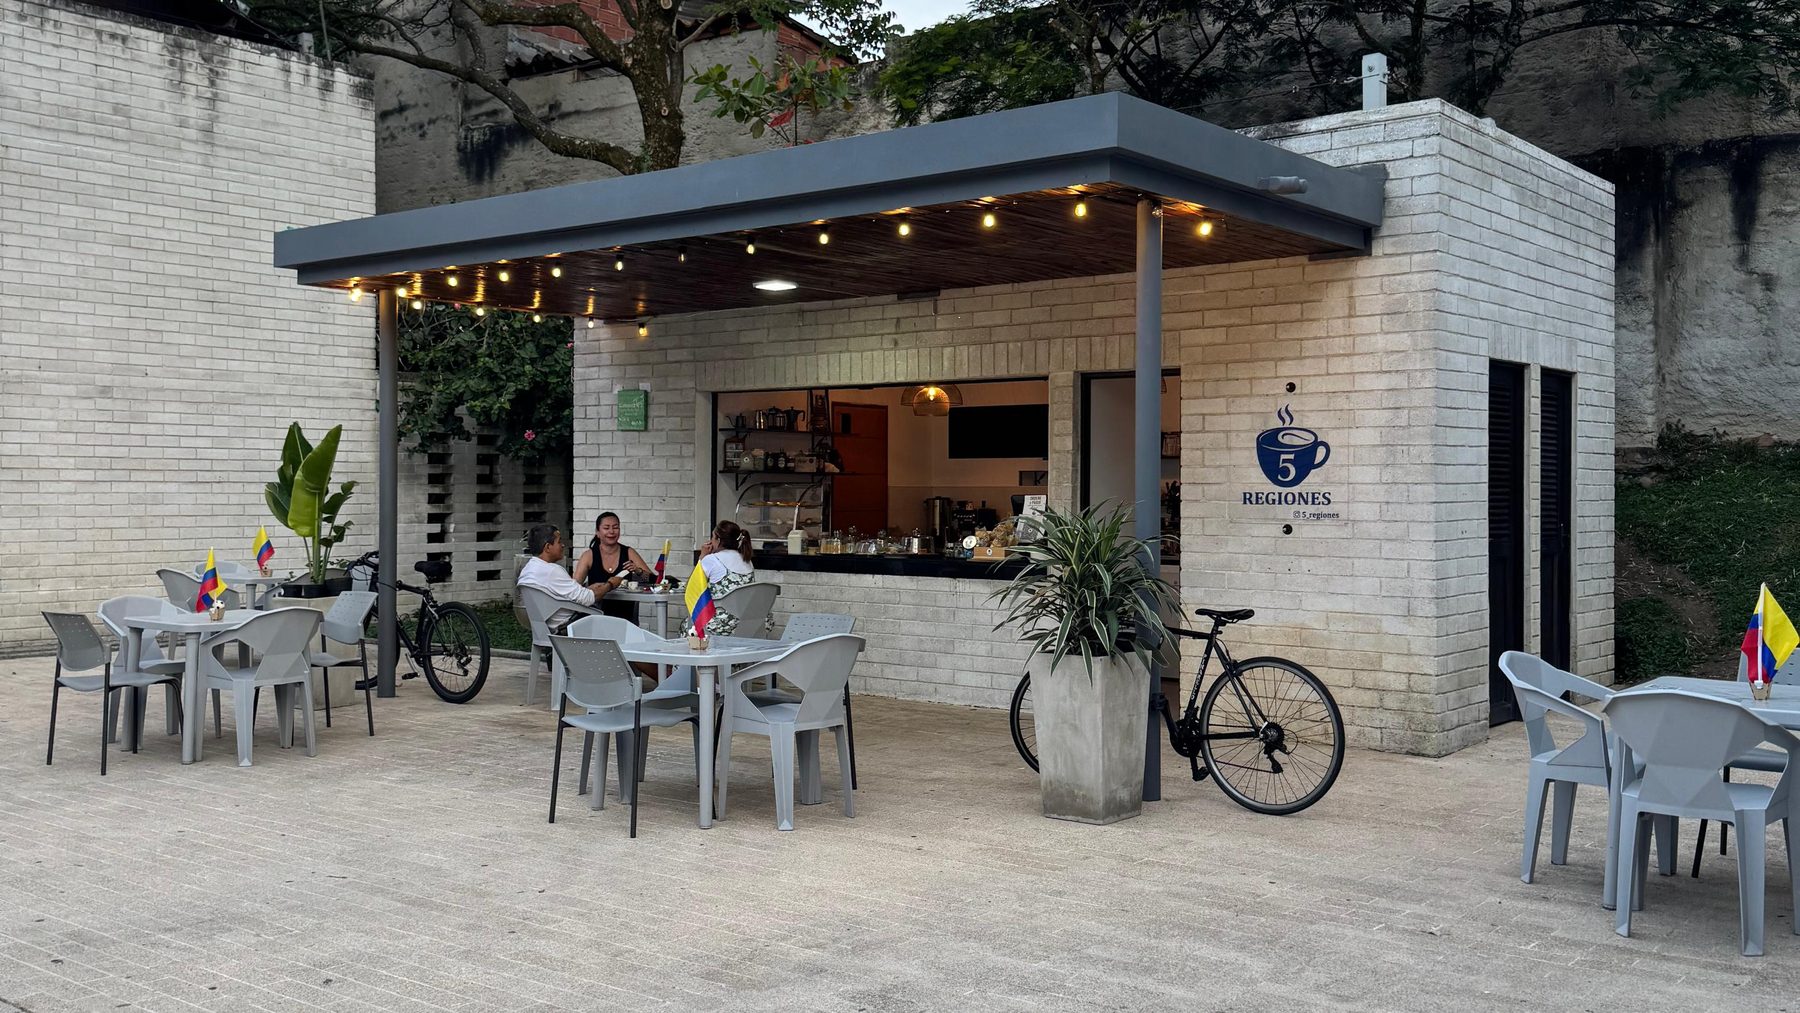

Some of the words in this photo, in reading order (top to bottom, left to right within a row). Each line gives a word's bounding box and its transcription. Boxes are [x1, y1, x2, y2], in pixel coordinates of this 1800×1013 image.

[1277, 453, 1296, 482] 5
[1242, 491, 1332, 506] REGIONES
[1301, 511, 1340, 520] 5_regiones
